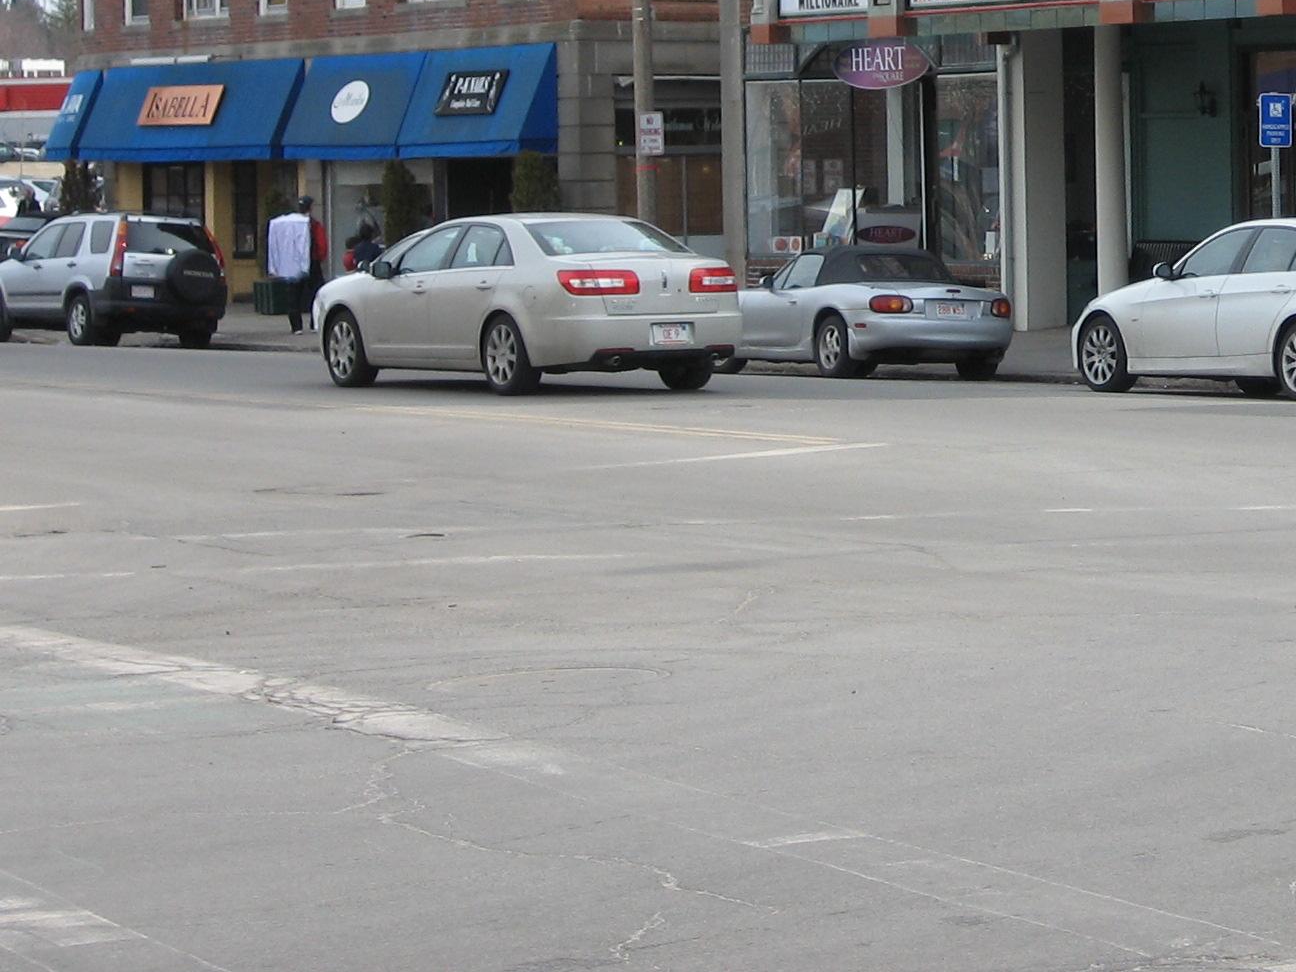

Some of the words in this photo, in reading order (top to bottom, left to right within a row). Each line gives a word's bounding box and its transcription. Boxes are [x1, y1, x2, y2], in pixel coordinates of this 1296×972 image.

[851, 46, 905, 72] HEART
[146, 91, 210, 119] ISABELLA
[869, 227, 903, 238] HEART
